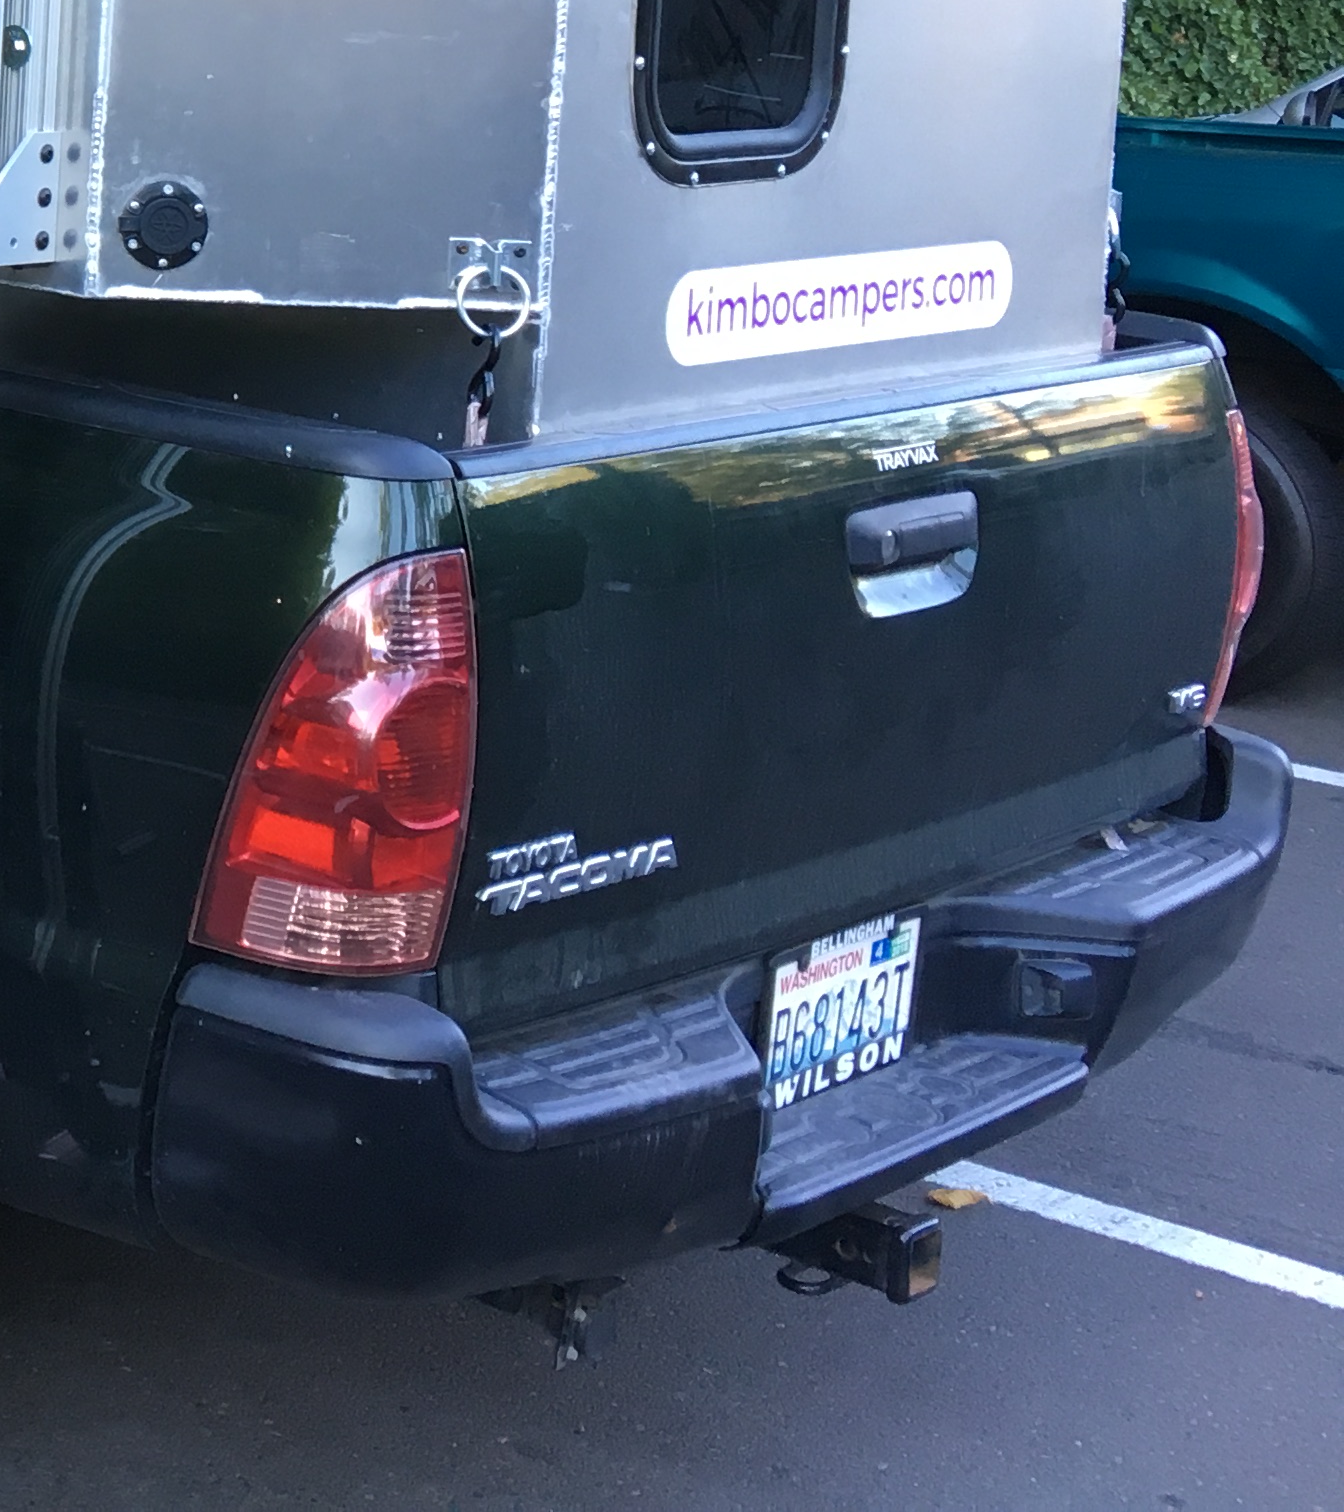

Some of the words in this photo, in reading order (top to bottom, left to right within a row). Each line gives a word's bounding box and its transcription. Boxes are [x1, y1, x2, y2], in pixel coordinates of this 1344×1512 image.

[686, 266, 995, 338] kimbocampers.com
[873, 445, 939, 472] TRAYVAX
[476, 836, 678, 916] TACOMA
[487, 831, 577, 879] TOYOTA
[811, 914, 895, 957] BELLINGHAM
[780, 948, 864, 995] WASHINGTON
[770, 961, 911, 1082] B68143T
[775, 1033, 905, 1110] WILSON
